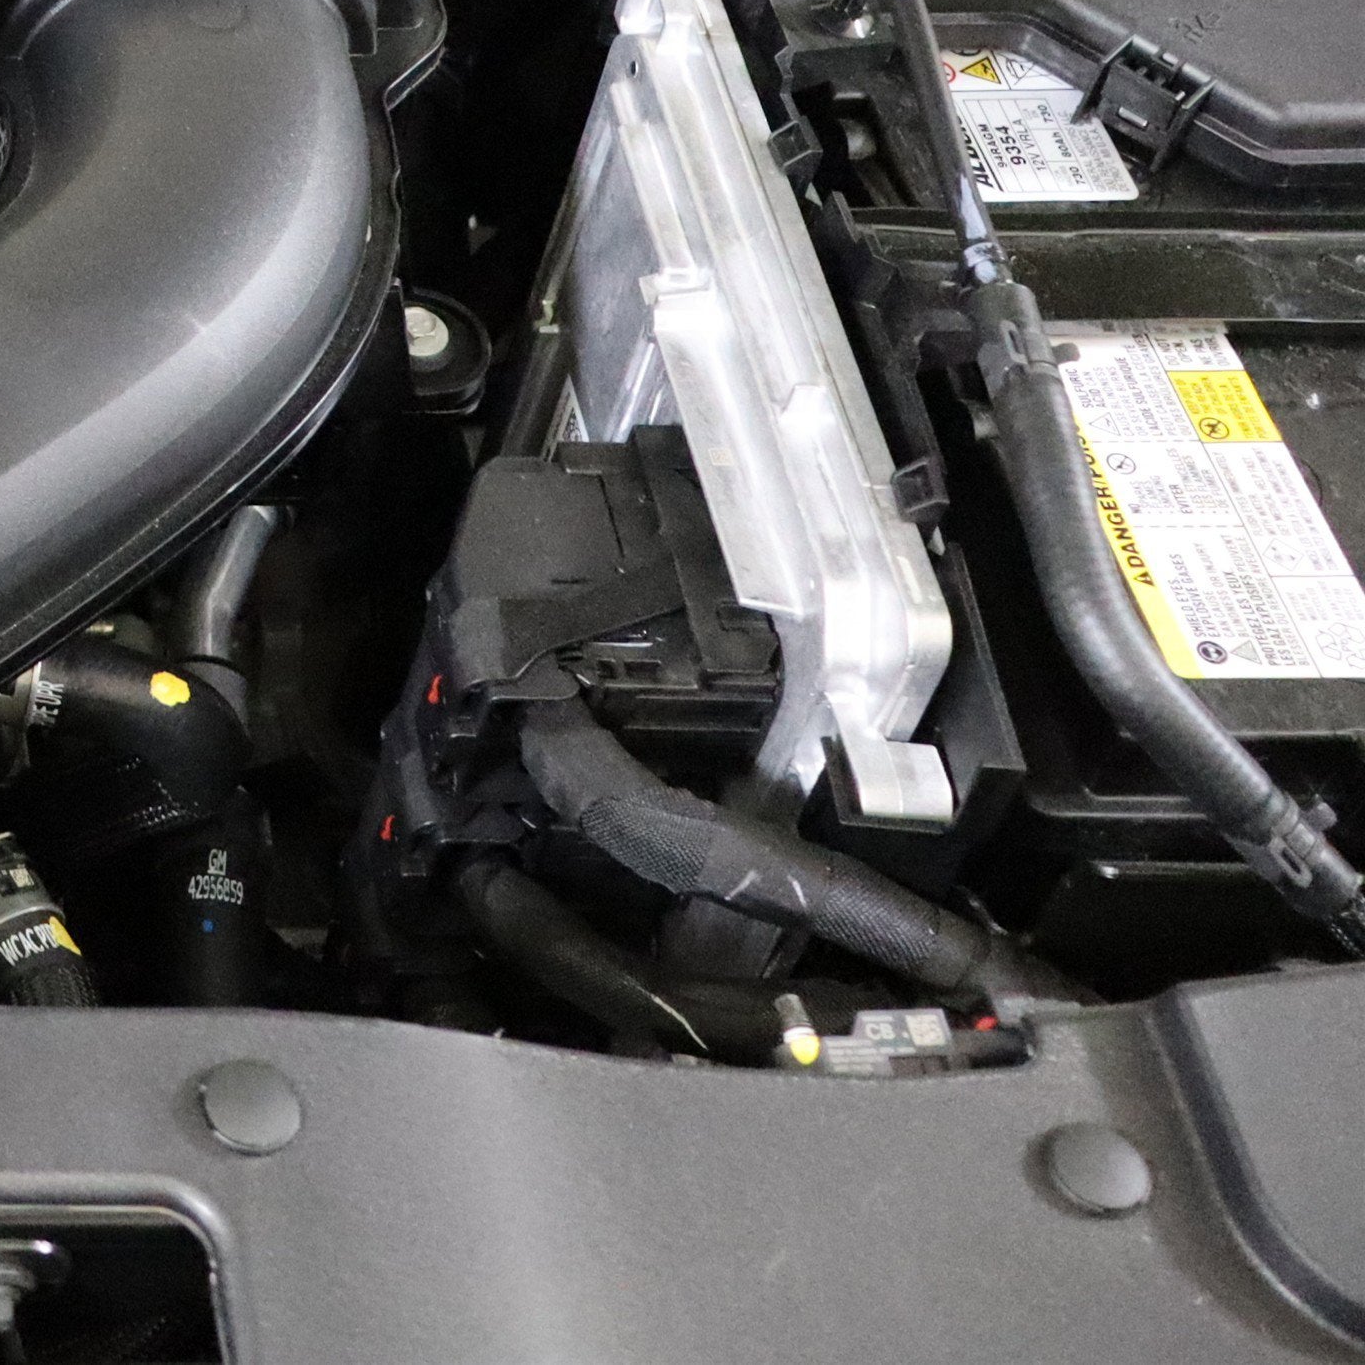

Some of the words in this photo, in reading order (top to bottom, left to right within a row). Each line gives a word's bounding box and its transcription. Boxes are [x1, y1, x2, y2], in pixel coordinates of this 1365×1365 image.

[1037, 104, 1053, 122] 730
[995, 126, 1026, 164] 9354
[1012, 119, 1035, 148] VRLA
[1053, 131, 1072, 157] 80Ah
[978, 124, 1007, 167] 94RAGM
[1029, 153, 1046, 170] 12V
[1069, 166, 1085, 184] 730
[1154, 338, 1170, 352] NOT
[1189, 338, 1204, 351] PAS
[1164, 355, 1180, 366] DO
[1200, 356, 1212, 365] NE
[1083, 371, 1096, 385] CAN
[1093, 367, 1121, 409] BLINDNESS
[1115, 357, 1147, 404] SULFURIQUE
[1139, 372, 1151, 381] LA
[1065, 369, 1093, 408] SULFURIC
[1088, 388, 1106, 408] ACID
[1144, 384, 1167, 414] CAUSER
[1119, 395, 1142, 422] SEVERE
[1115, 412, 1135, 435] CAUSE
[1134, 425, 1149, 435] OR
[1159, 417, 1177, 435] PEUT
[1128, 503, 1141, 513] NO
[1190, 494, 1205, 508] LES
[1201, 494, 1218, 508] LES
[1221, 535, 1245, 572] PEUVENT
[1169, 554, 1193, 583] GASES
[1209, 576, 1224, 587] OR
[1203, 591, 1225, 617] CAUSE
[1236, 598, 1255, 614] LES
[1239, 575, 1274, 624] EXPLOSIFS
[1181, 605, 1206, 637] SHIELD
[1186, 587, 1220, 637] EXPLOSIVE
[1217, 590, 1249, 637] BLINDNESS
[1219, 620, 1235, 637] CAN
[1266, 628, 1286, 646] GAZ
[1277, 649, 1296, 666] LES
[1282, 628, 1310, 665] BLESSER
[34, 680, 66, 707] UPR
[207, 848, 228, 876] GM
[187, 874, 245, 905] 42956859
